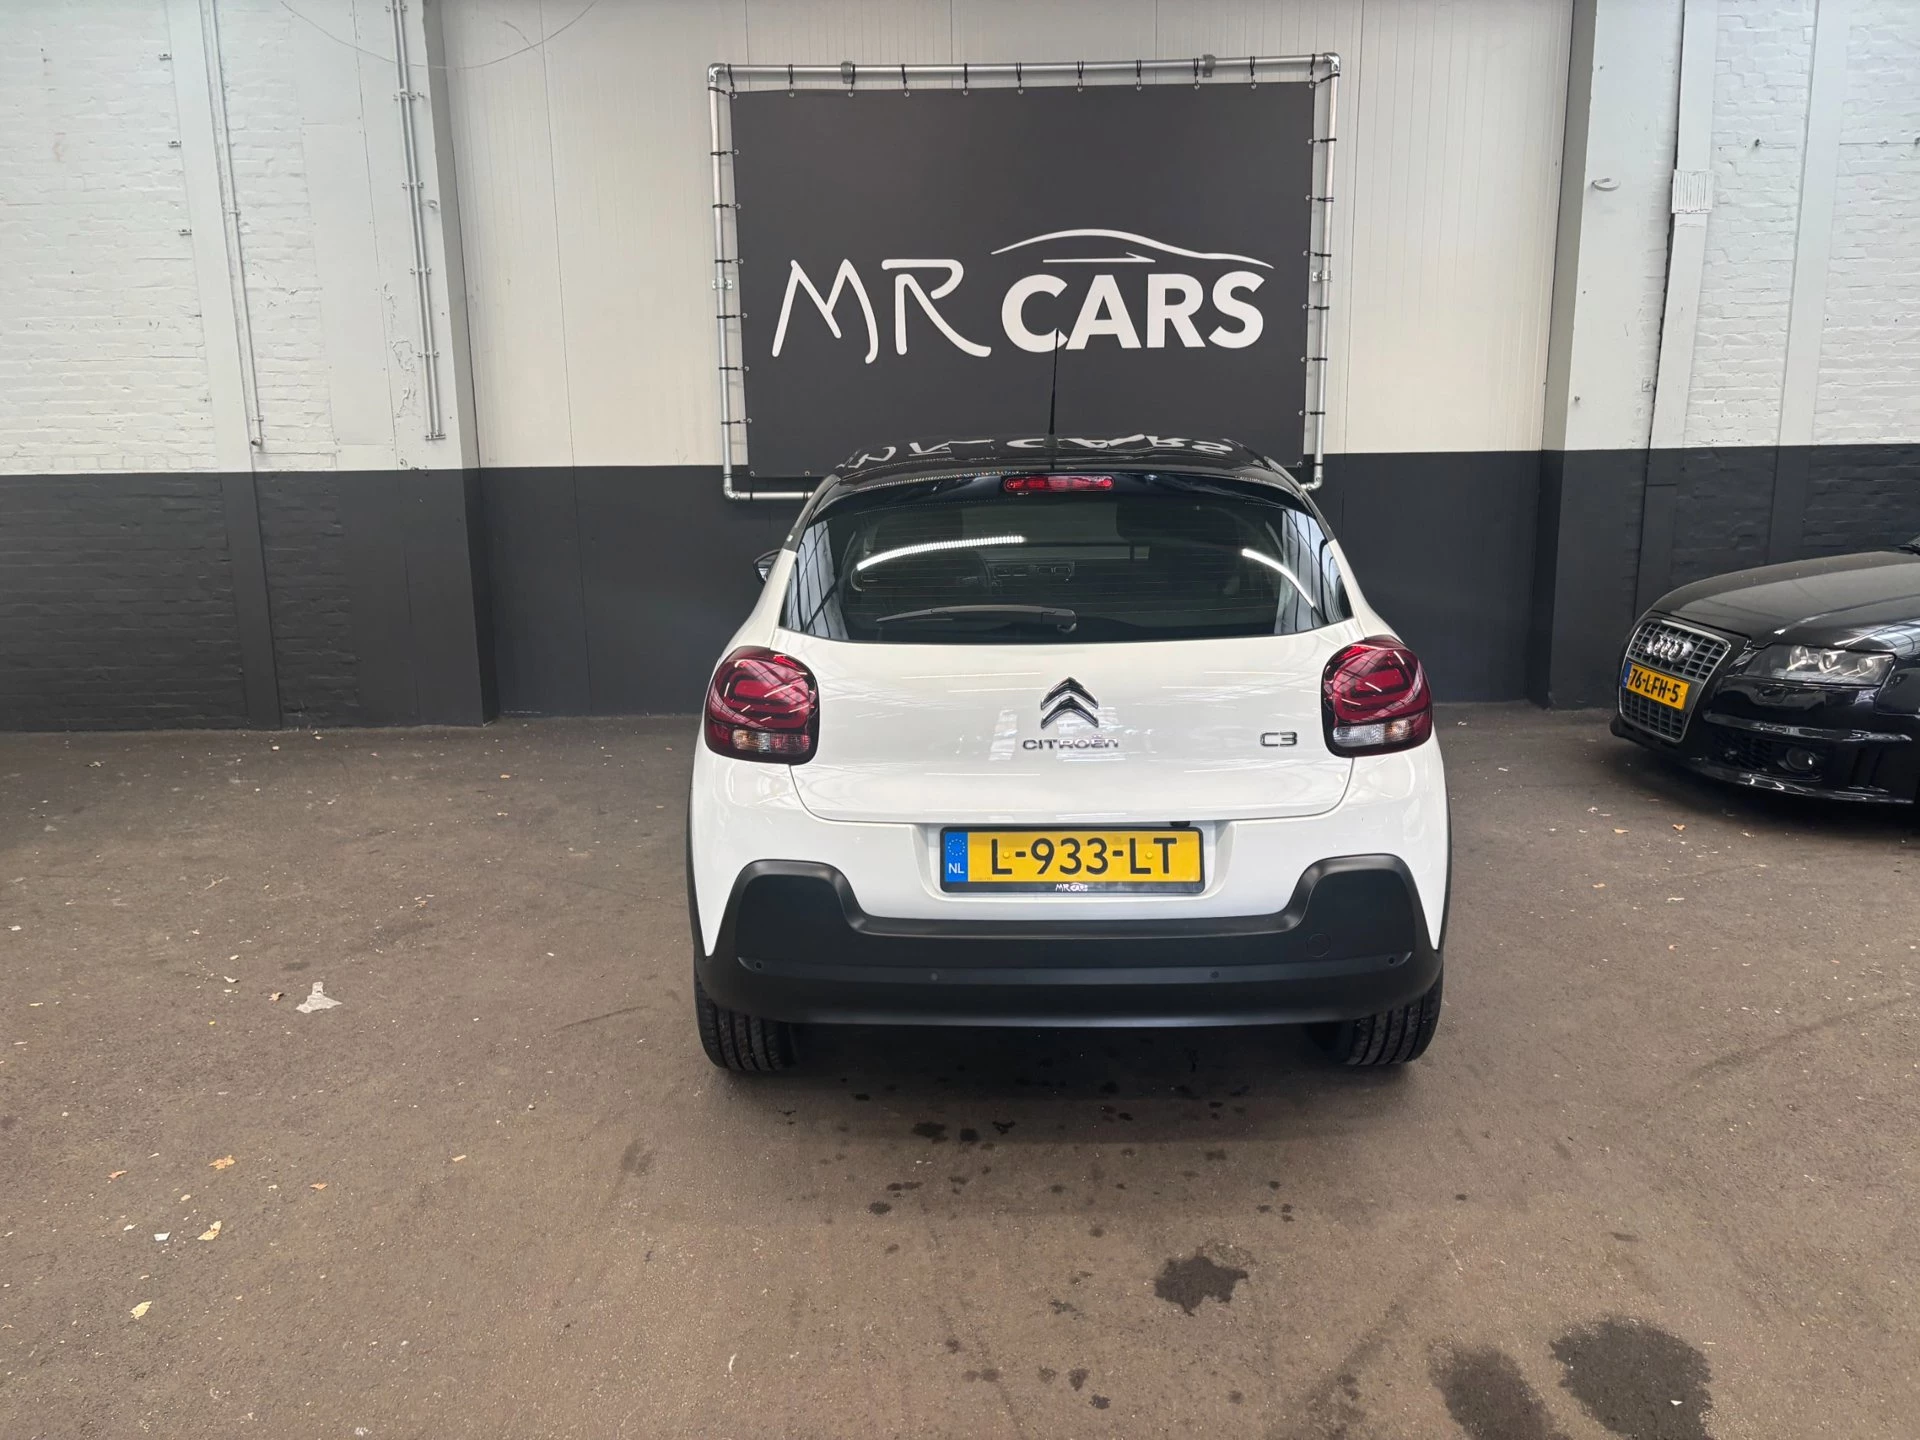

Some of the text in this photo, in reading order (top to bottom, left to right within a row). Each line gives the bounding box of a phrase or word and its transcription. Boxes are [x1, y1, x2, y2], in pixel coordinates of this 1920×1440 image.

[772, 258, 1266, 364] MR CARS
[1629, 668, 1682, 703] 76-LFH-5
[1260, 731, 1298, 747] C3
[948, 837, 1178, 875] NL L-933-LT
[1055, 883, 1070, 893] MR
